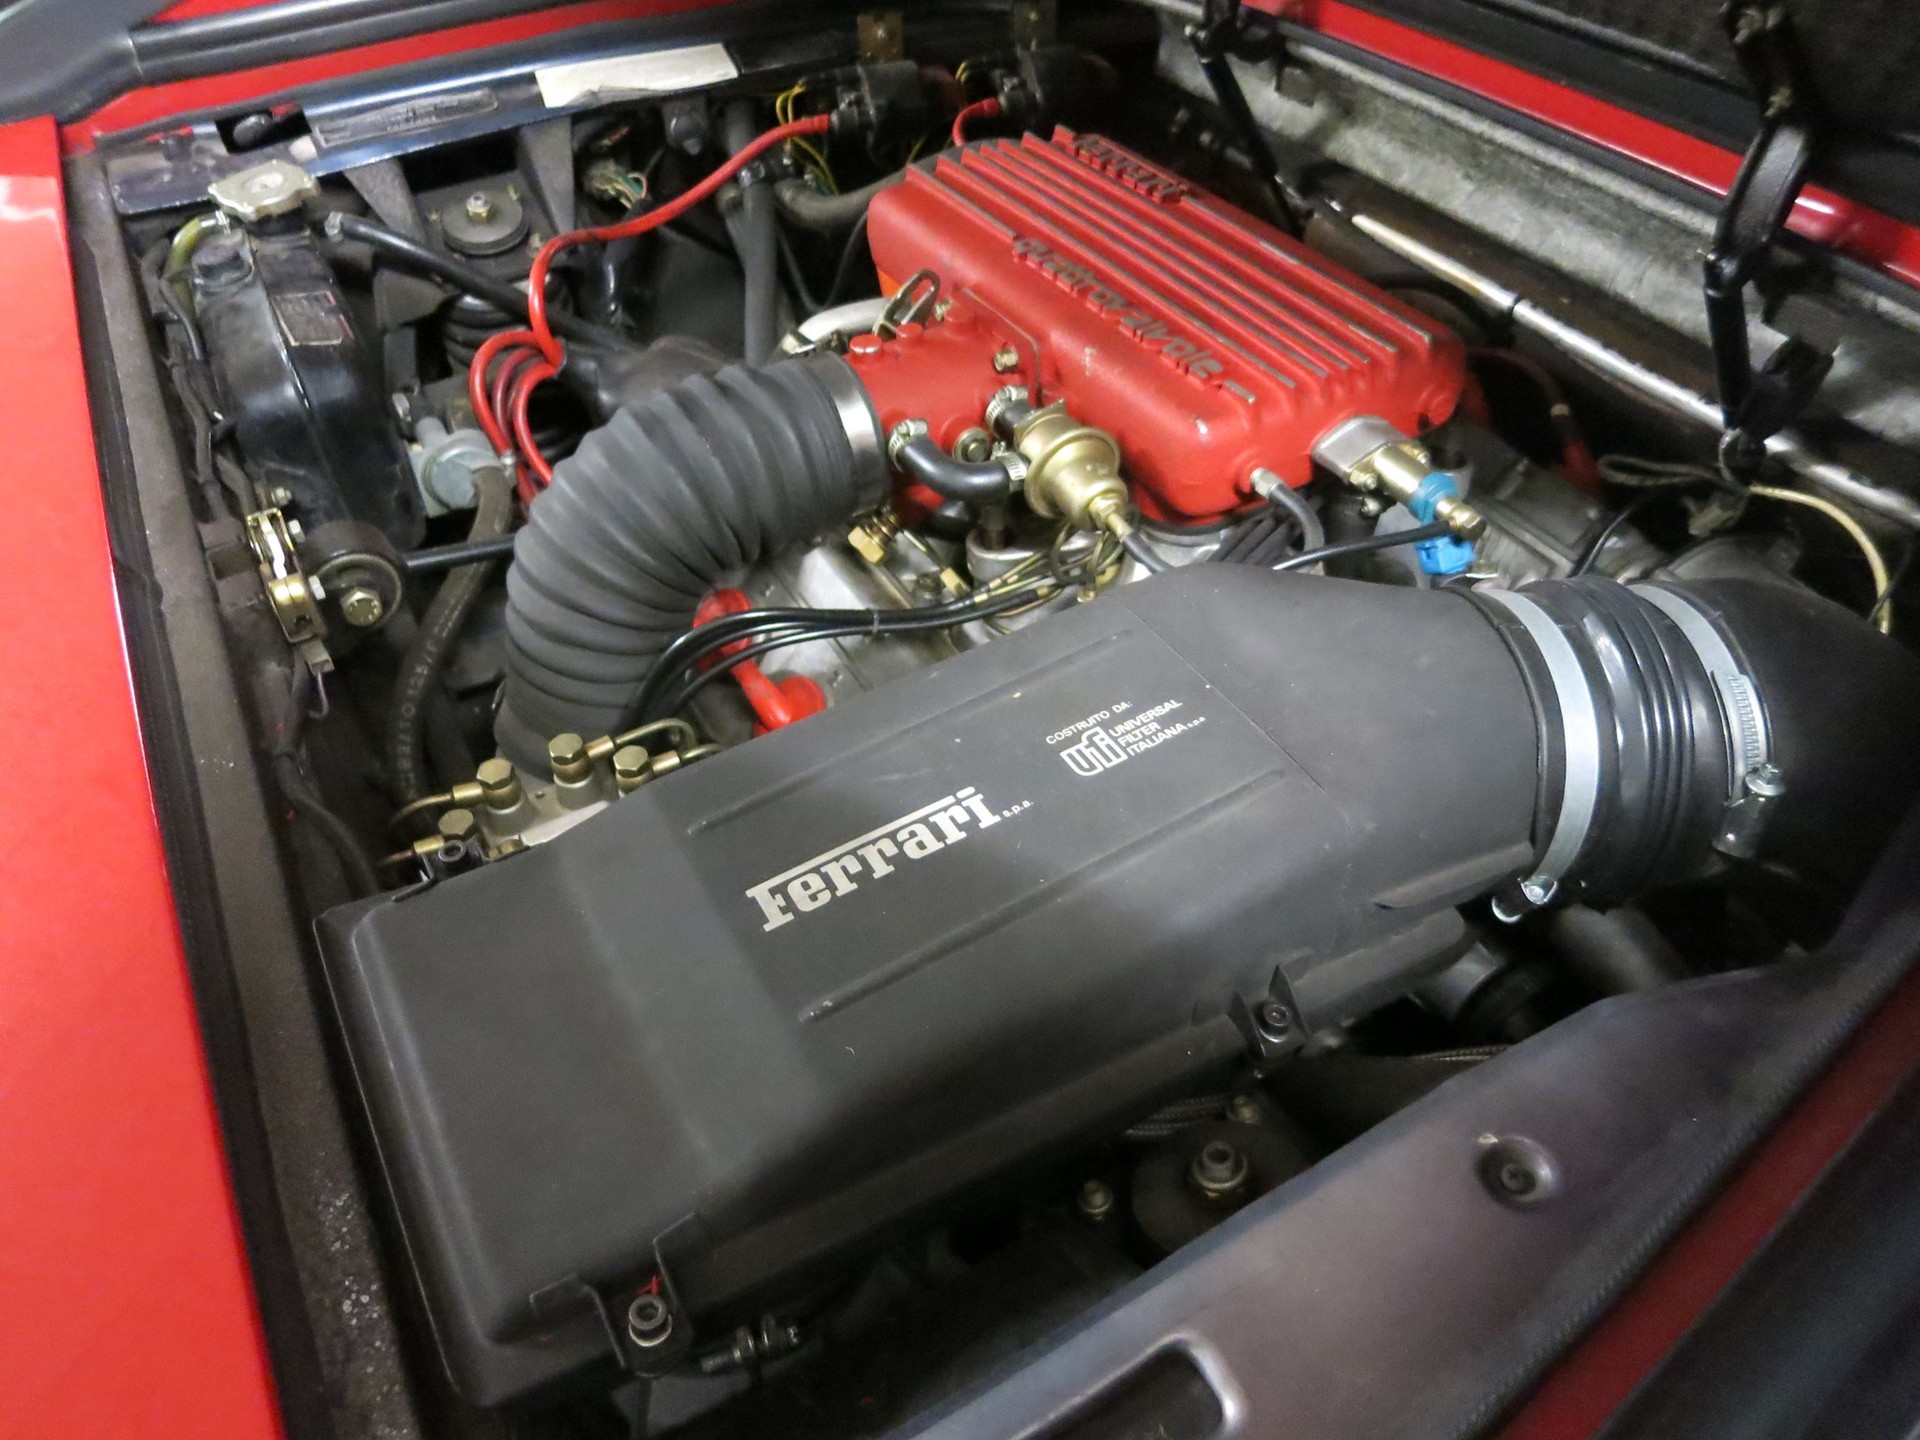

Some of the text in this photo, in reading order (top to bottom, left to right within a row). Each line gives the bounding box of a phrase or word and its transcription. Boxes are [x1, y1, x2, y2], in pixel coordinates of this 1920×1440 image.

[1045, 700, 1133, 745] COSTRUITO DA:
[1108, 699, 1182, 737] UNIVERSAL
[1117, 721, 1161, 748] FILTER
[1126, 722, 1187, 756] ITALIANA
[745, 786, 1001, 932] Ferrari
